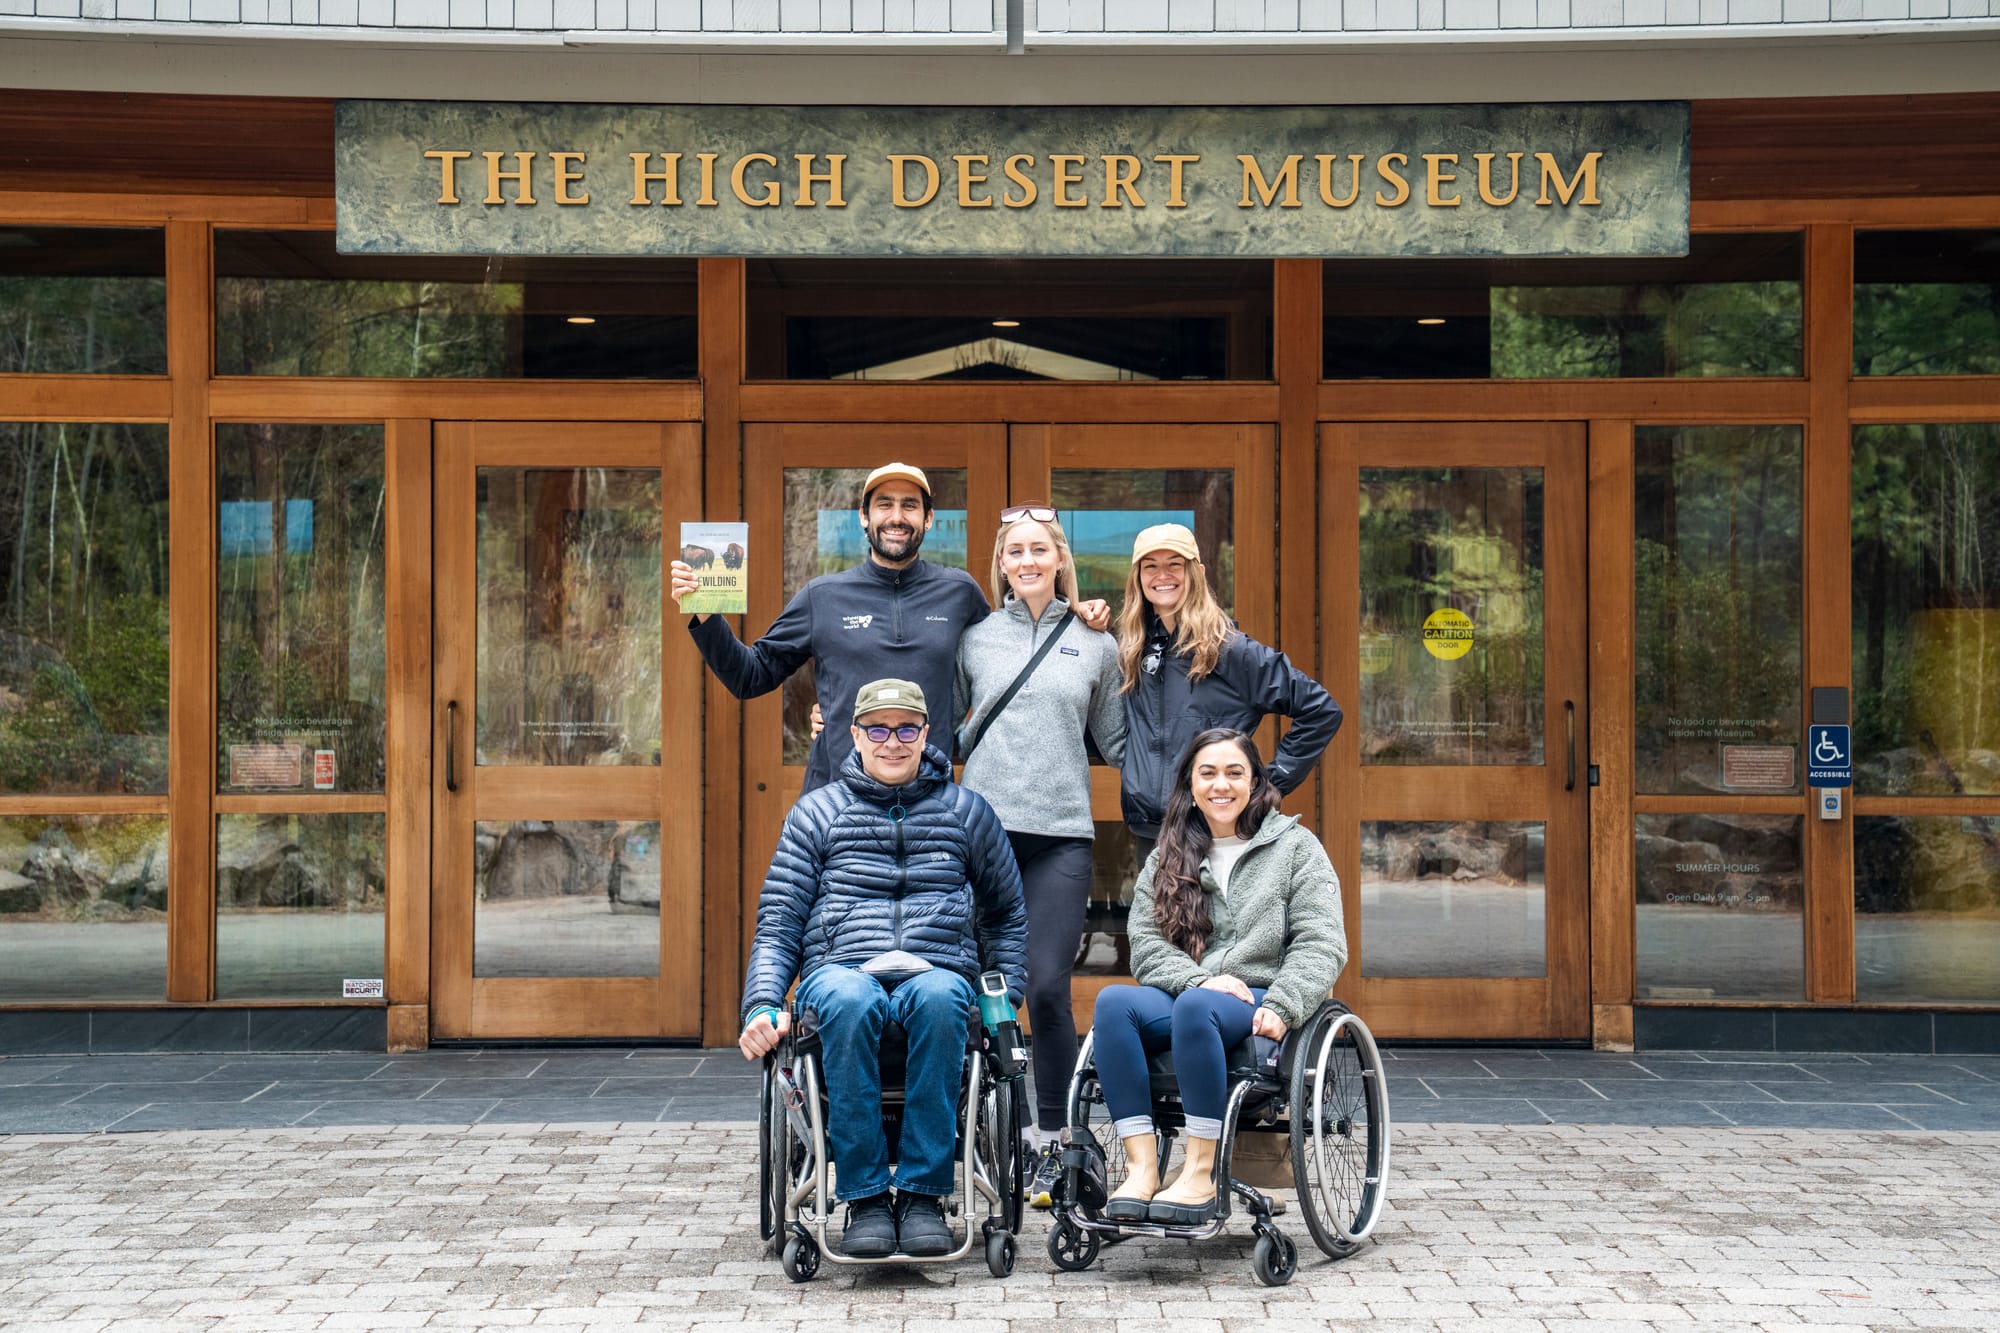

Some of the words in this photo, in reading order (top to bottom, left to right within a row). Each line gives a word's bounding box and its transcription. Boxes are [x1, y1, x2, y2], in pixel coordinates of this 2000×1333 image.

[423, 150, 590, 205] THE
[629, 152, 848, 207] HIGH
[886, 152, 1201, 208] DESERT
[1237, 151, 1604, 207] MUSEUM
[697, 576, 737, 587] EWILDING
[1424, 630, 1473, 639] CAUTION
[255, 717, 269, 725] No
[271, 717, 292, 725] food
[306, 717, 353, 727] beverages
[1668, 718, 1681, 726] No
[1683, 718, 1705, 726] food
[1718, 718, 1766, 728] beverages
[255, 728, 282, 736] inside
[285, 728, 300, 736] the
[1668, 729, 1695, 737] inside
[1697, 729, 1712, 737] the
[1714, 729, 1756, 737] Museum.
[1675, 863, 1721, 873] SUMMER
[1723, 863, 1761, 873] HOURS
[1666, 893, 1691, 902] Open
[1693, 893, 1716, 902] Daily
[1717, 893, 1724, 901] 9
[1747, 893, 1754, 901] 5
[1755, 895, 1770, 903] pm
